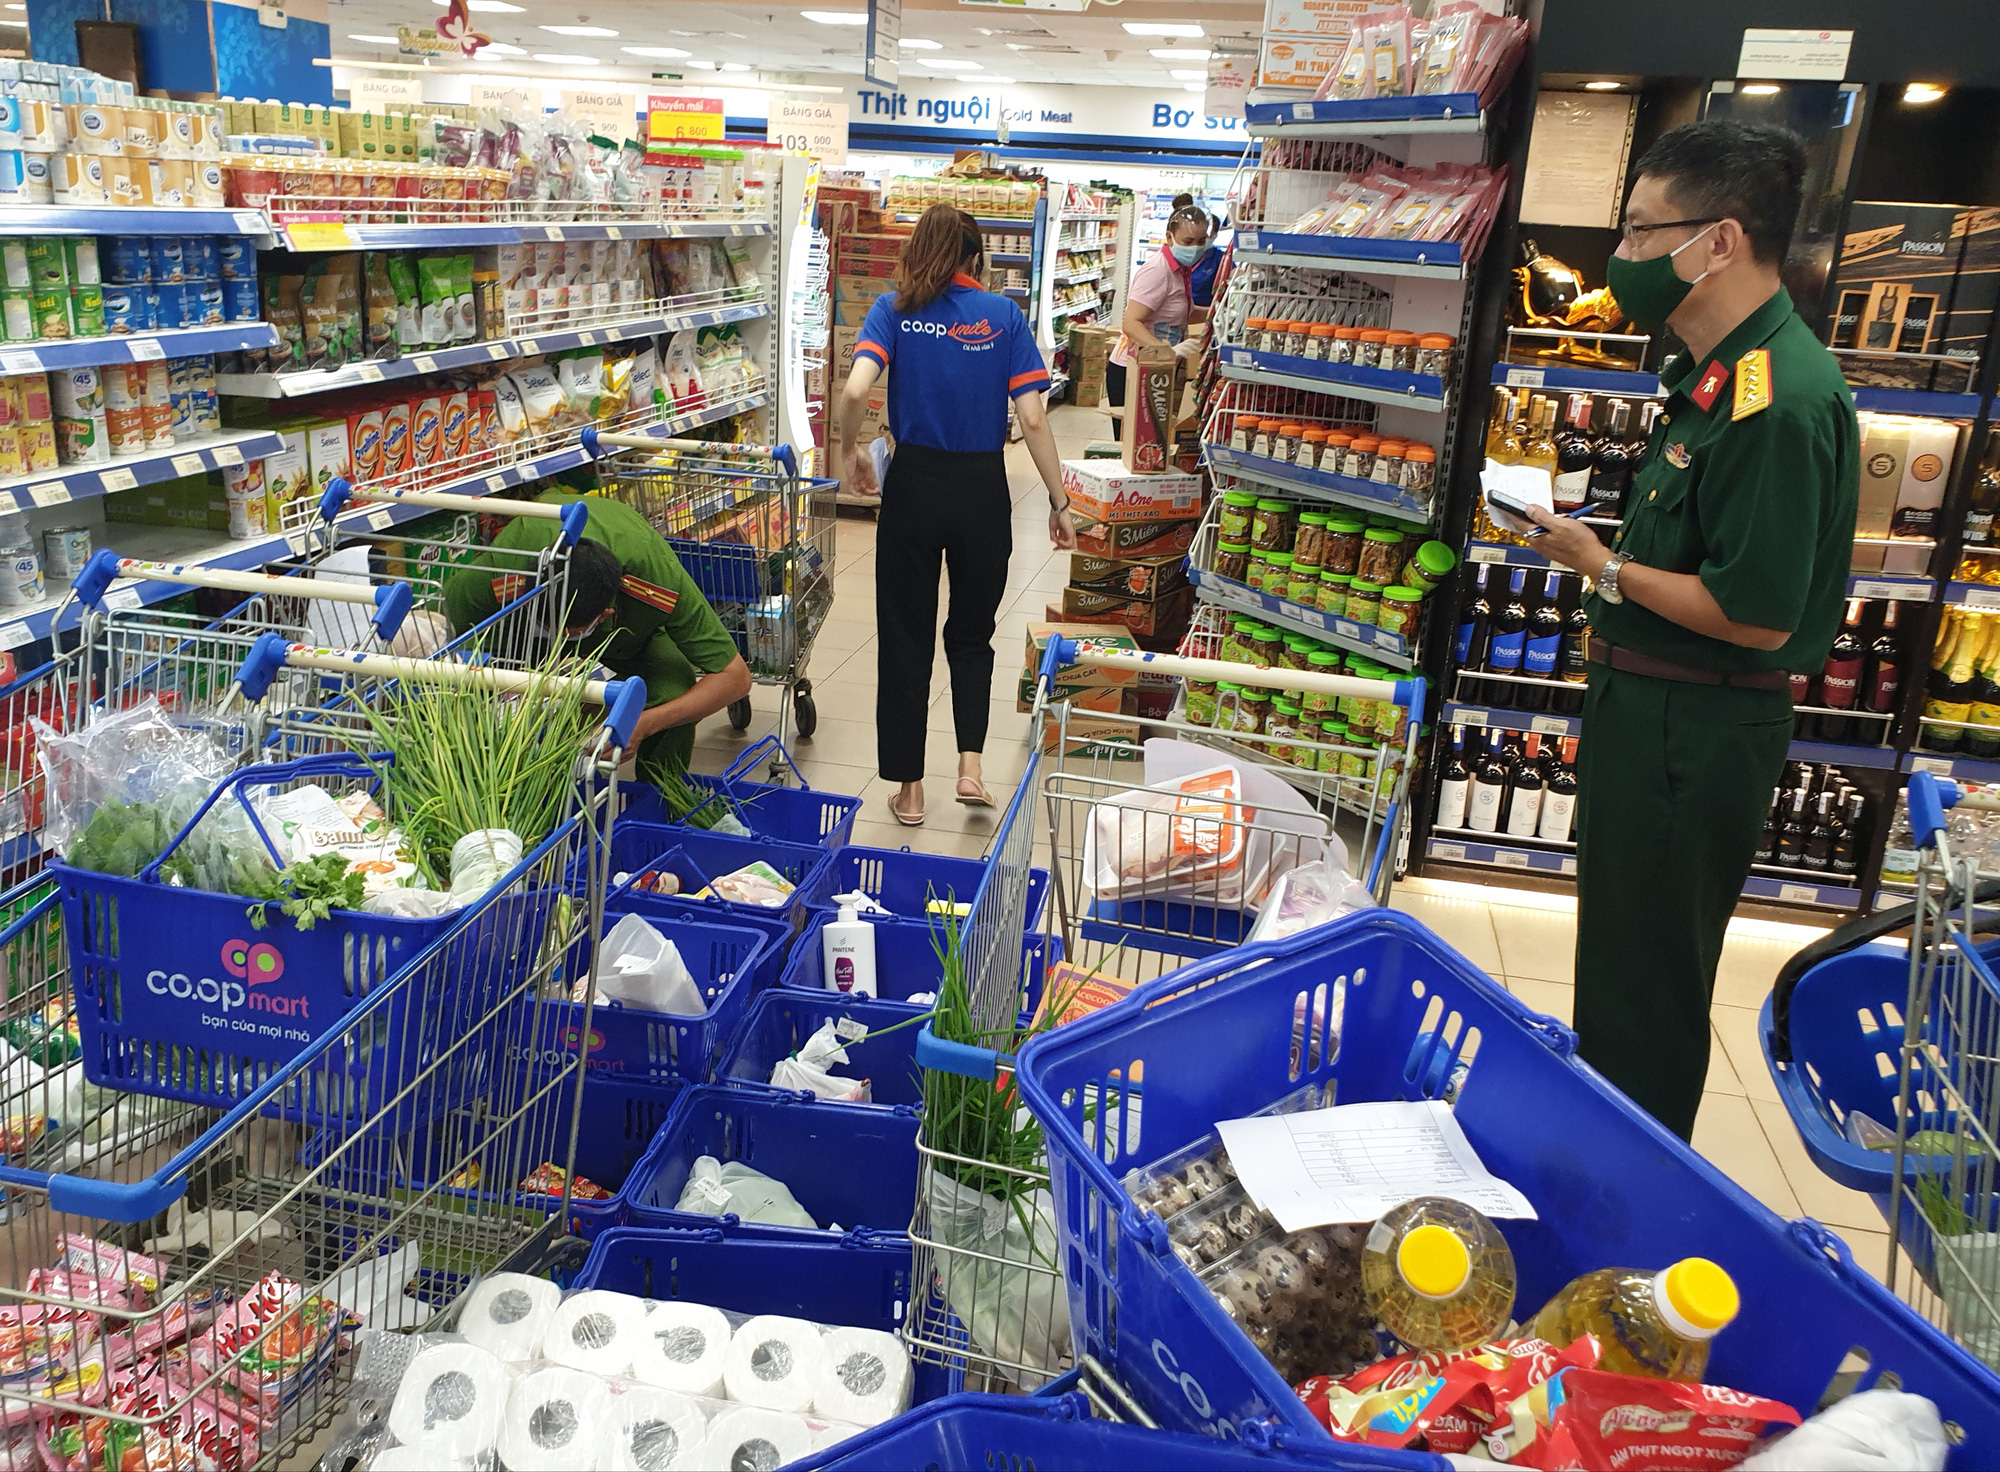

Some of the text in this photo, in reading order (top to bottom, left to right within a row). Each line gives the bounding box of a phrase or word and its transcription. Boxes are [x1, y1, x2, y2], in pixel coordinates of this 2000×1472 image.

[857, 91, 990, 124] Thịt nguội
[1002, 108, 1073, 123] Cold Meat
[1153, 104, 1195, 128] Bơ
[1901, 240, 1946, 253] PASSION
[901, 318, 992, 339] co.op smile
[1112, 490, 1153, 508] A-One
[1590, 486, 1620, 499] PASSION
[421, 547, 439, 564] MILO
[1824, 674, 1856, 687] PASSION
[146, 970, 310, 1018] co.op mart
[202, 1013, 310, 1042] bạn của mọi nhà
[1660, 1445, 1704, 1459] NGỌT
